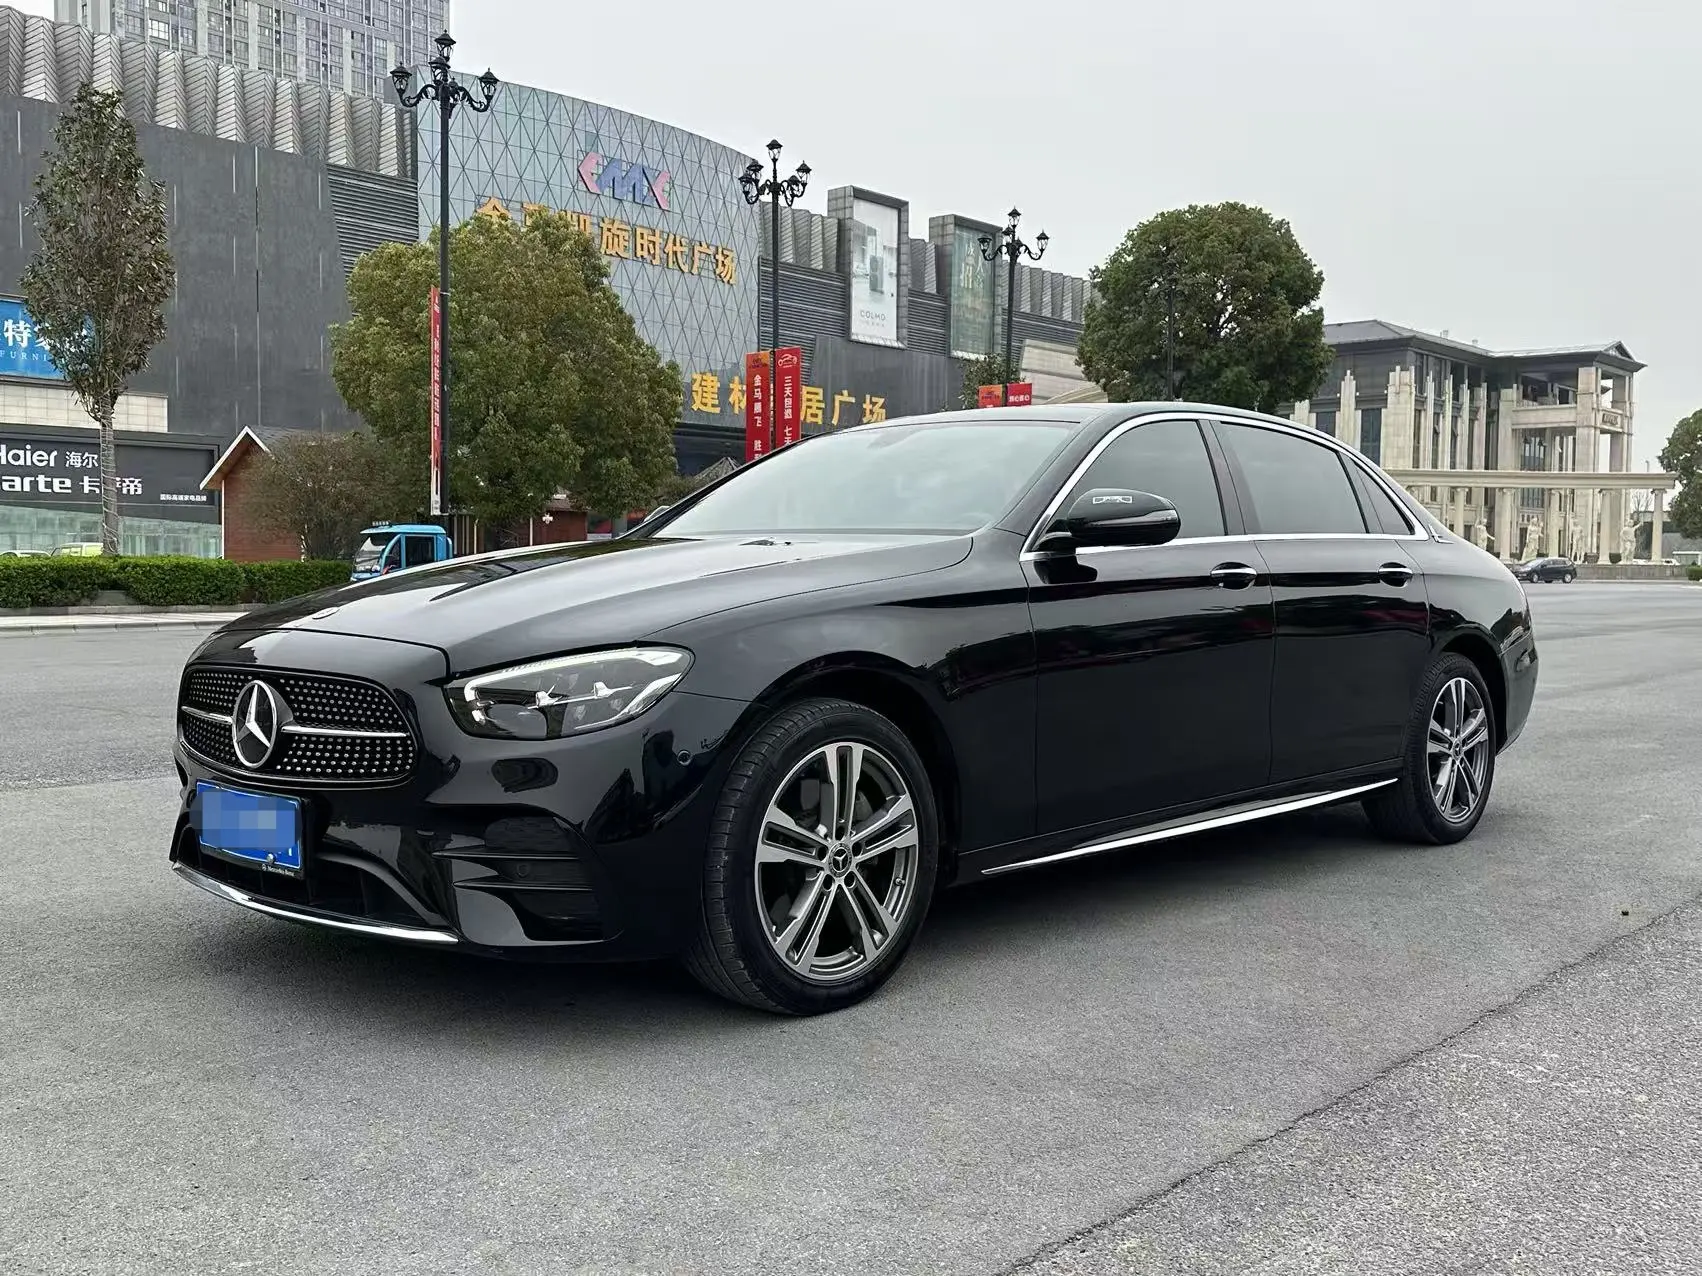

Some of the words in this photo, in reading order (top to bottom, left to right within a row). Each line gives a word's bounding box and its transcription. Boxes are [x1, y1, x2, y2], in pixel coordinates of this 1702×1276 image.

[691, 372, 887, 425] 建材居广场
[65, 451, 99, 468] 海尔
[79, 475, 143, 495] 卡帝
